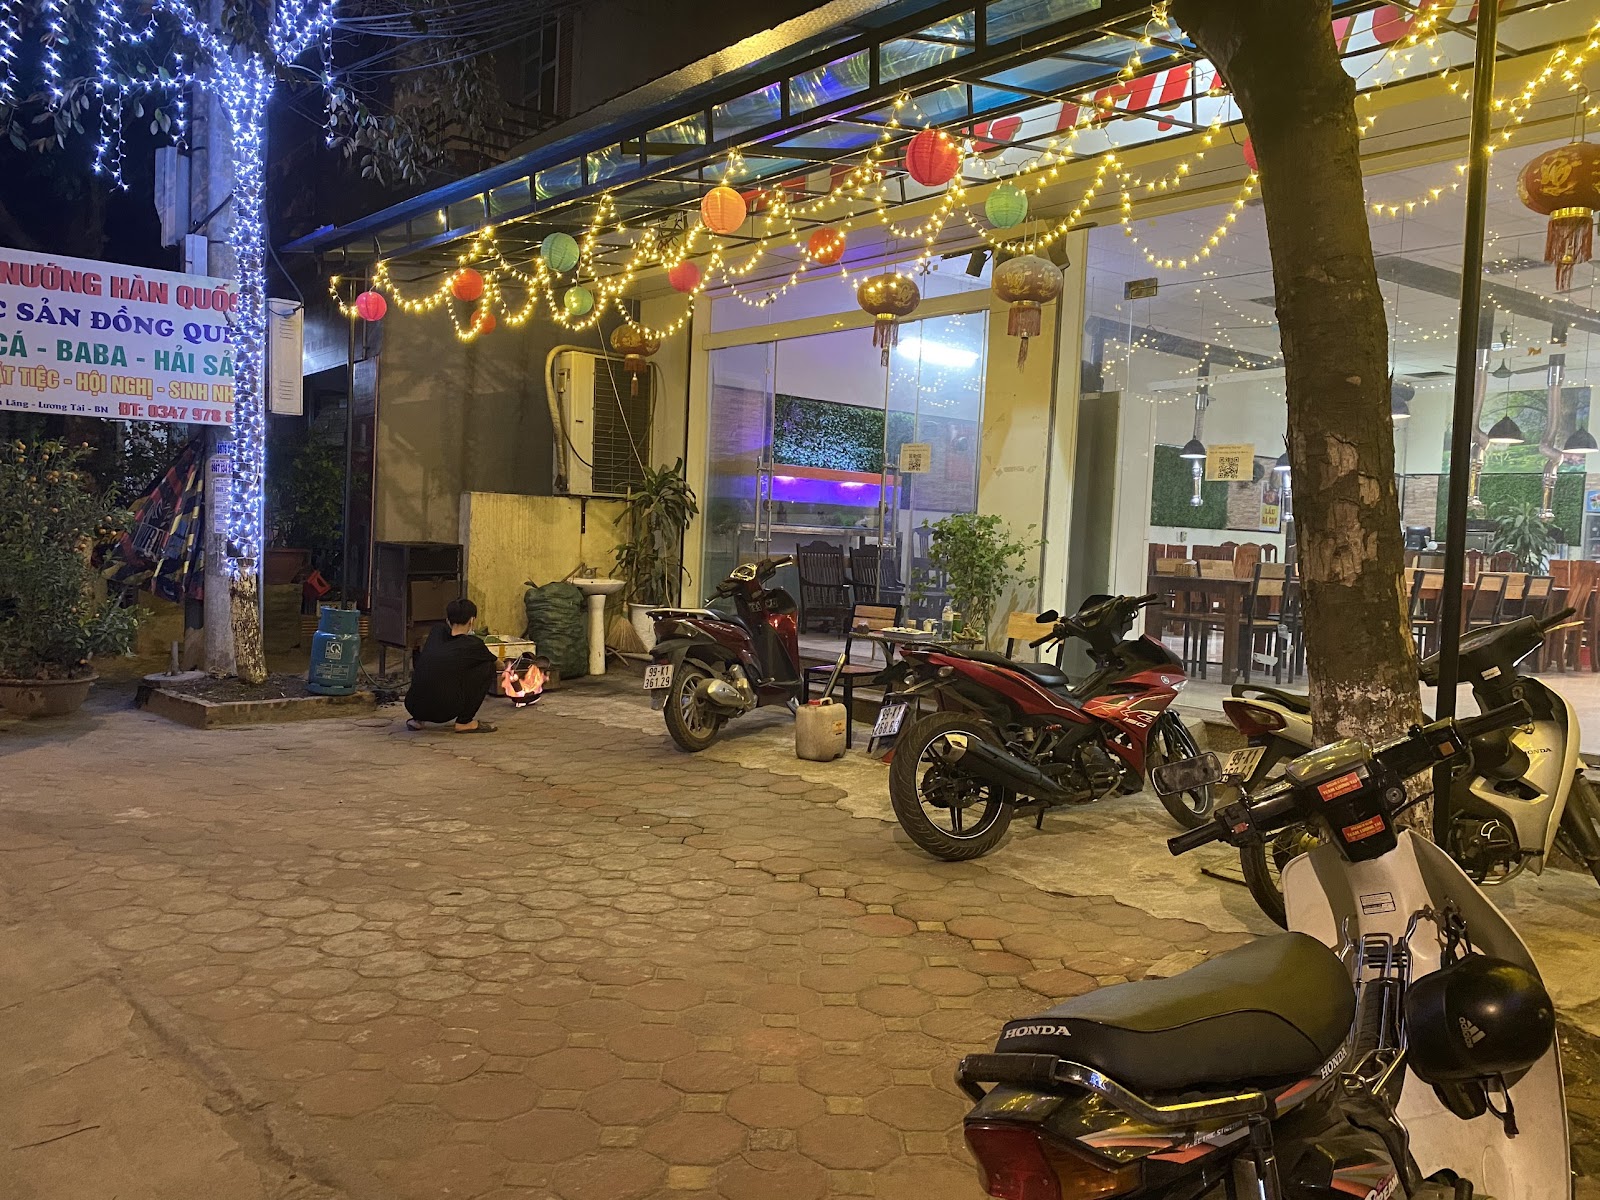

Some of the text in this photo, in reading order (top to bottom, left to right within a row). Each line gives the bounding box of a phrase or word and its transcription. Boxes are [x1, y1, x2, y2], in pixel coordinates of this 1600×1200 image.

[0, 261, 102, 296] NƯỚNG
[110, 274, 168, 304] HÀN
[16, 297, 81, 327] SẢN
[90, 305, 174, 337] ĐỒNG
[57, 339, 128, 367] BABA
[154, 344, 194, 373] HẢI
[203, 350, 236, 377] SẢ
[18, 365, 60, 392] TIỆC
[76, 370, 107, 396] HỘI
[111, 375, 153, 400] NGHỊ
[169, 381, 208, 401] SINH
[94, 405, 109, 413] BN
[148, 405, 188, 420] 0347
[192, 408, 221, 422] 978
[644, 676, 670, 688] 361.29
[649, 666, 670, 677] 99-K1
[1230, 750, 1258, 766] 99-K1
[1003, 1025, 1072, 1040] HONDA
[1458, 1016, 1474, 1049] adidas
[1320, 1046, 1348, 1080] HONDA
